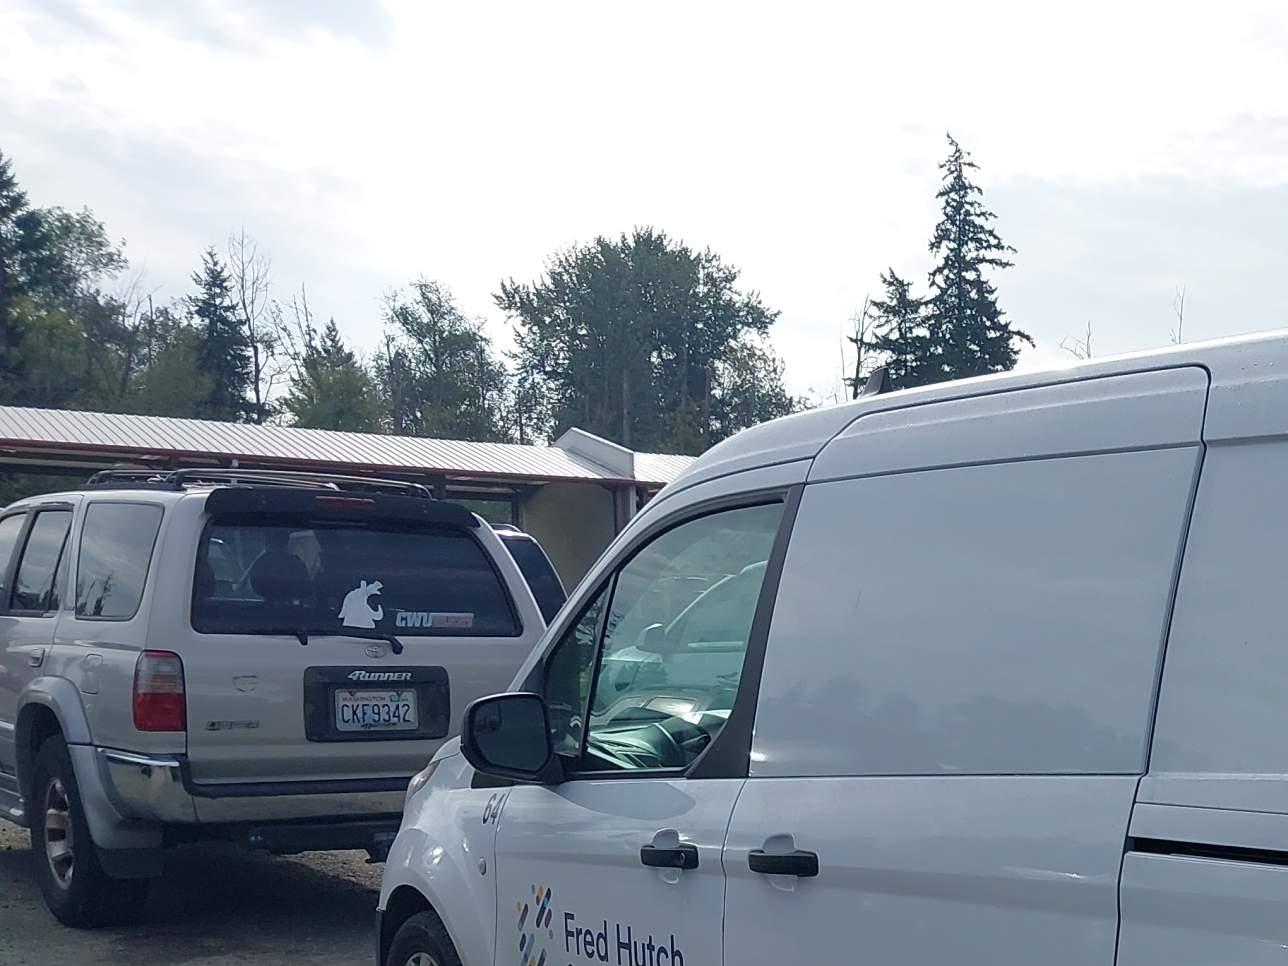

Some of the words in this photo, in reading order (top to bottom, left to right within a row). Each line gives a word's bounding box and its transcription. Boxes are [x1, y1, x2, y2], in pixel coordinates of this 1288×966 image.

[396, 612, 432, 627] CWU
[341, 703, 411, 723] CKF9342
[564, 912, 609, 963] Fred
